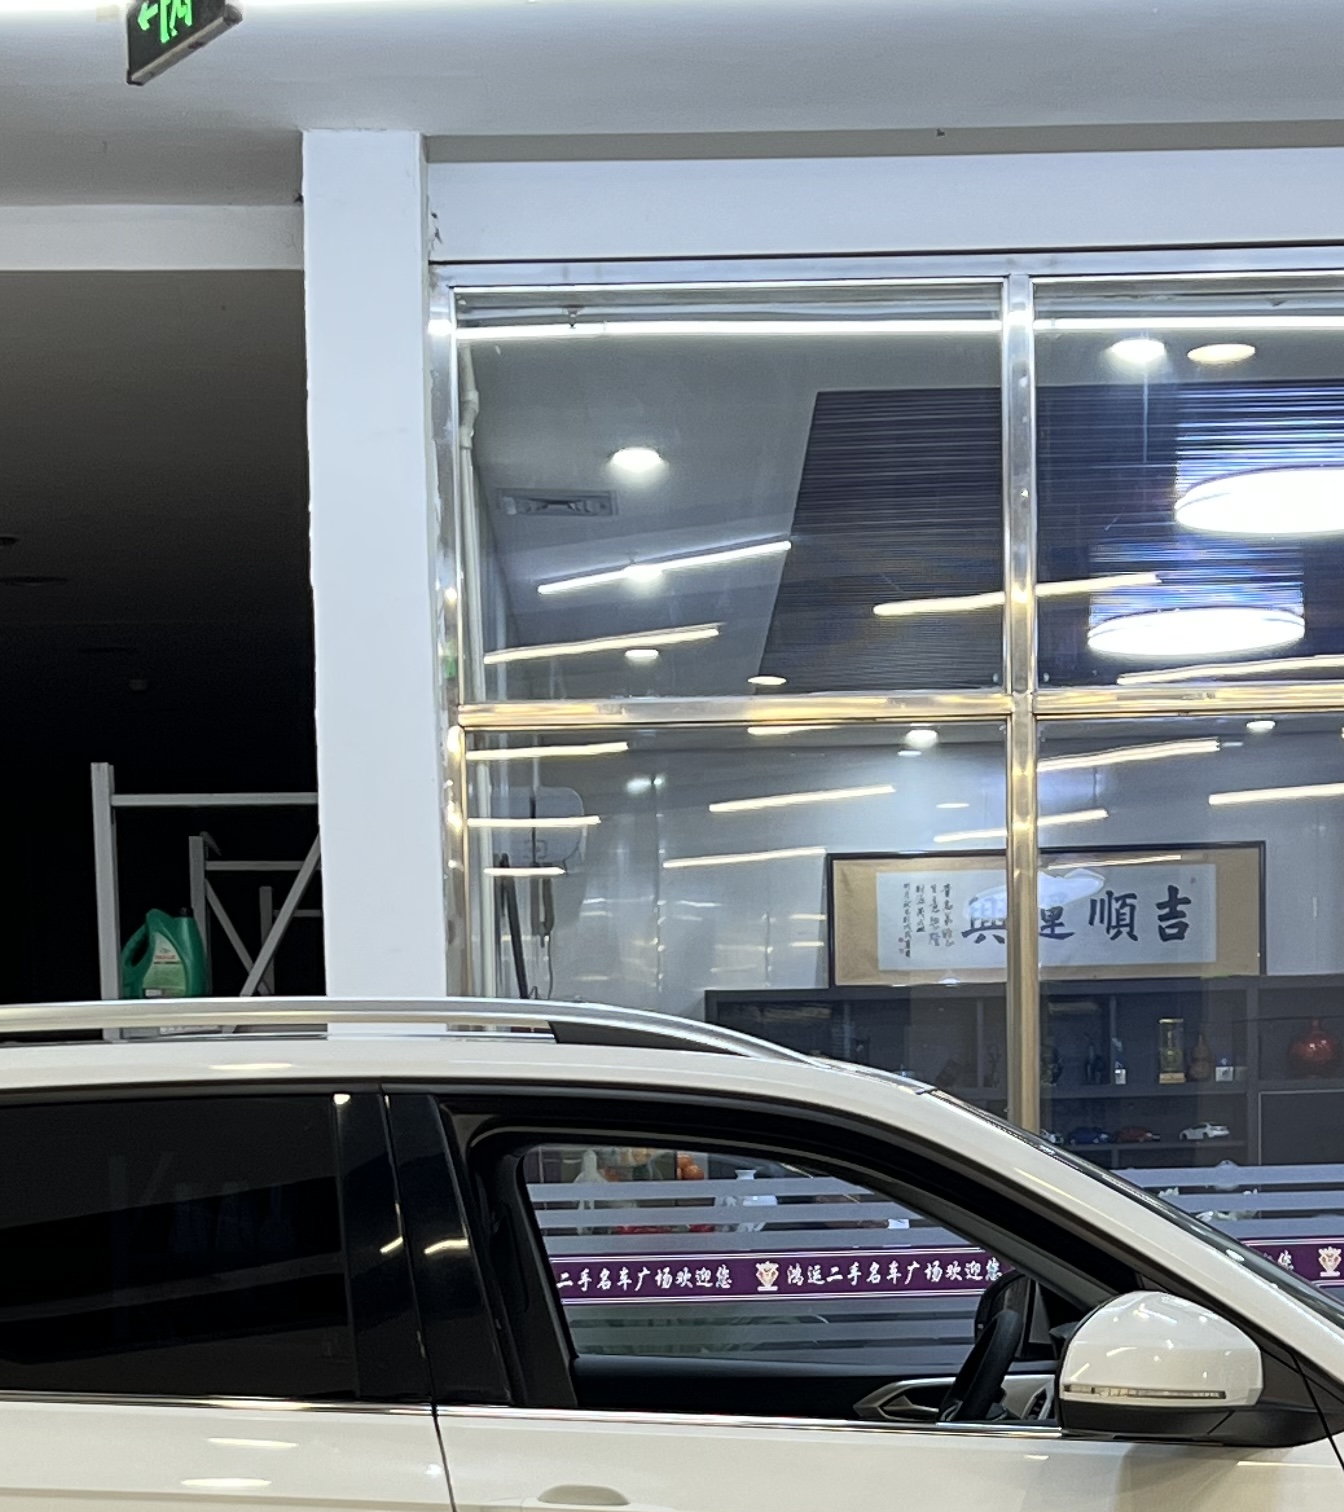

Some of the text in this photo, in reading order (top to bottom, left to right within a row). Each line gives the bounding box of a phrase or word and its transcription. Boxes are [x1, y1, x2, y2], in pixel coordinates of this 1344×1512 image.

[787, 1257, 1003, 1285] 鸿运二手名车广场欢迎您
